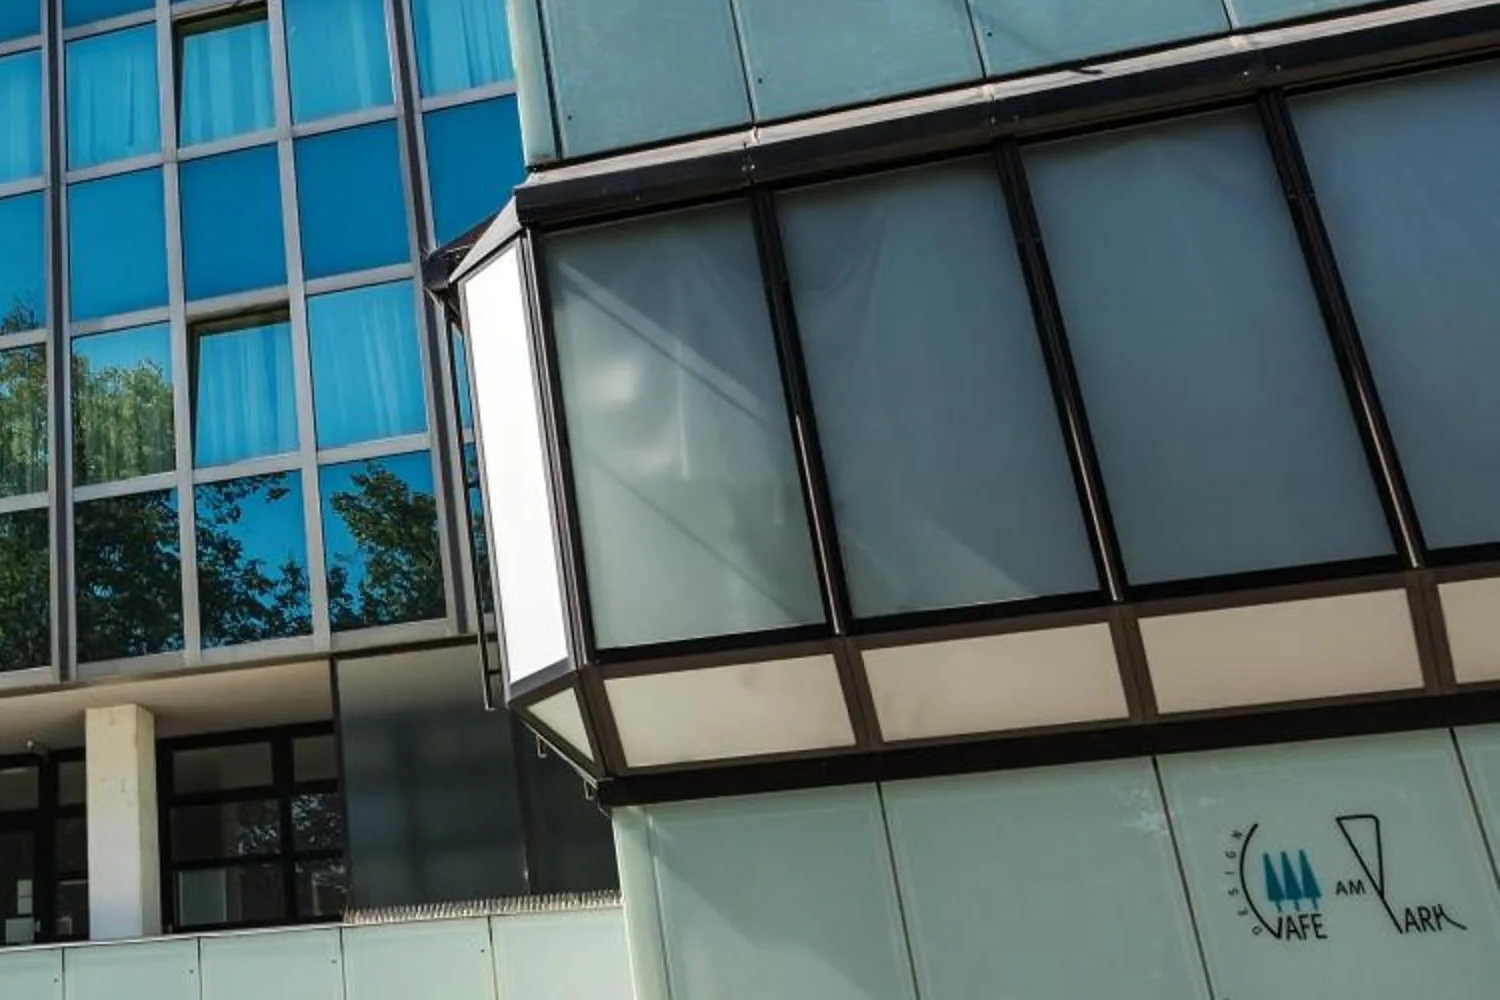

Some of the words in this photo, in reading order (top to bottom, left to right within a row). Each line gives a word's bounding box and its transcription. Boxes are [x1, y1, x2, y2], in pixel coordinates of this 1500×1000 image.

[1225, 828, 1263, 937] DESIGN
[1335, 879, 1367, 897] AM
[1336, 814, 1467, 934] PARK
